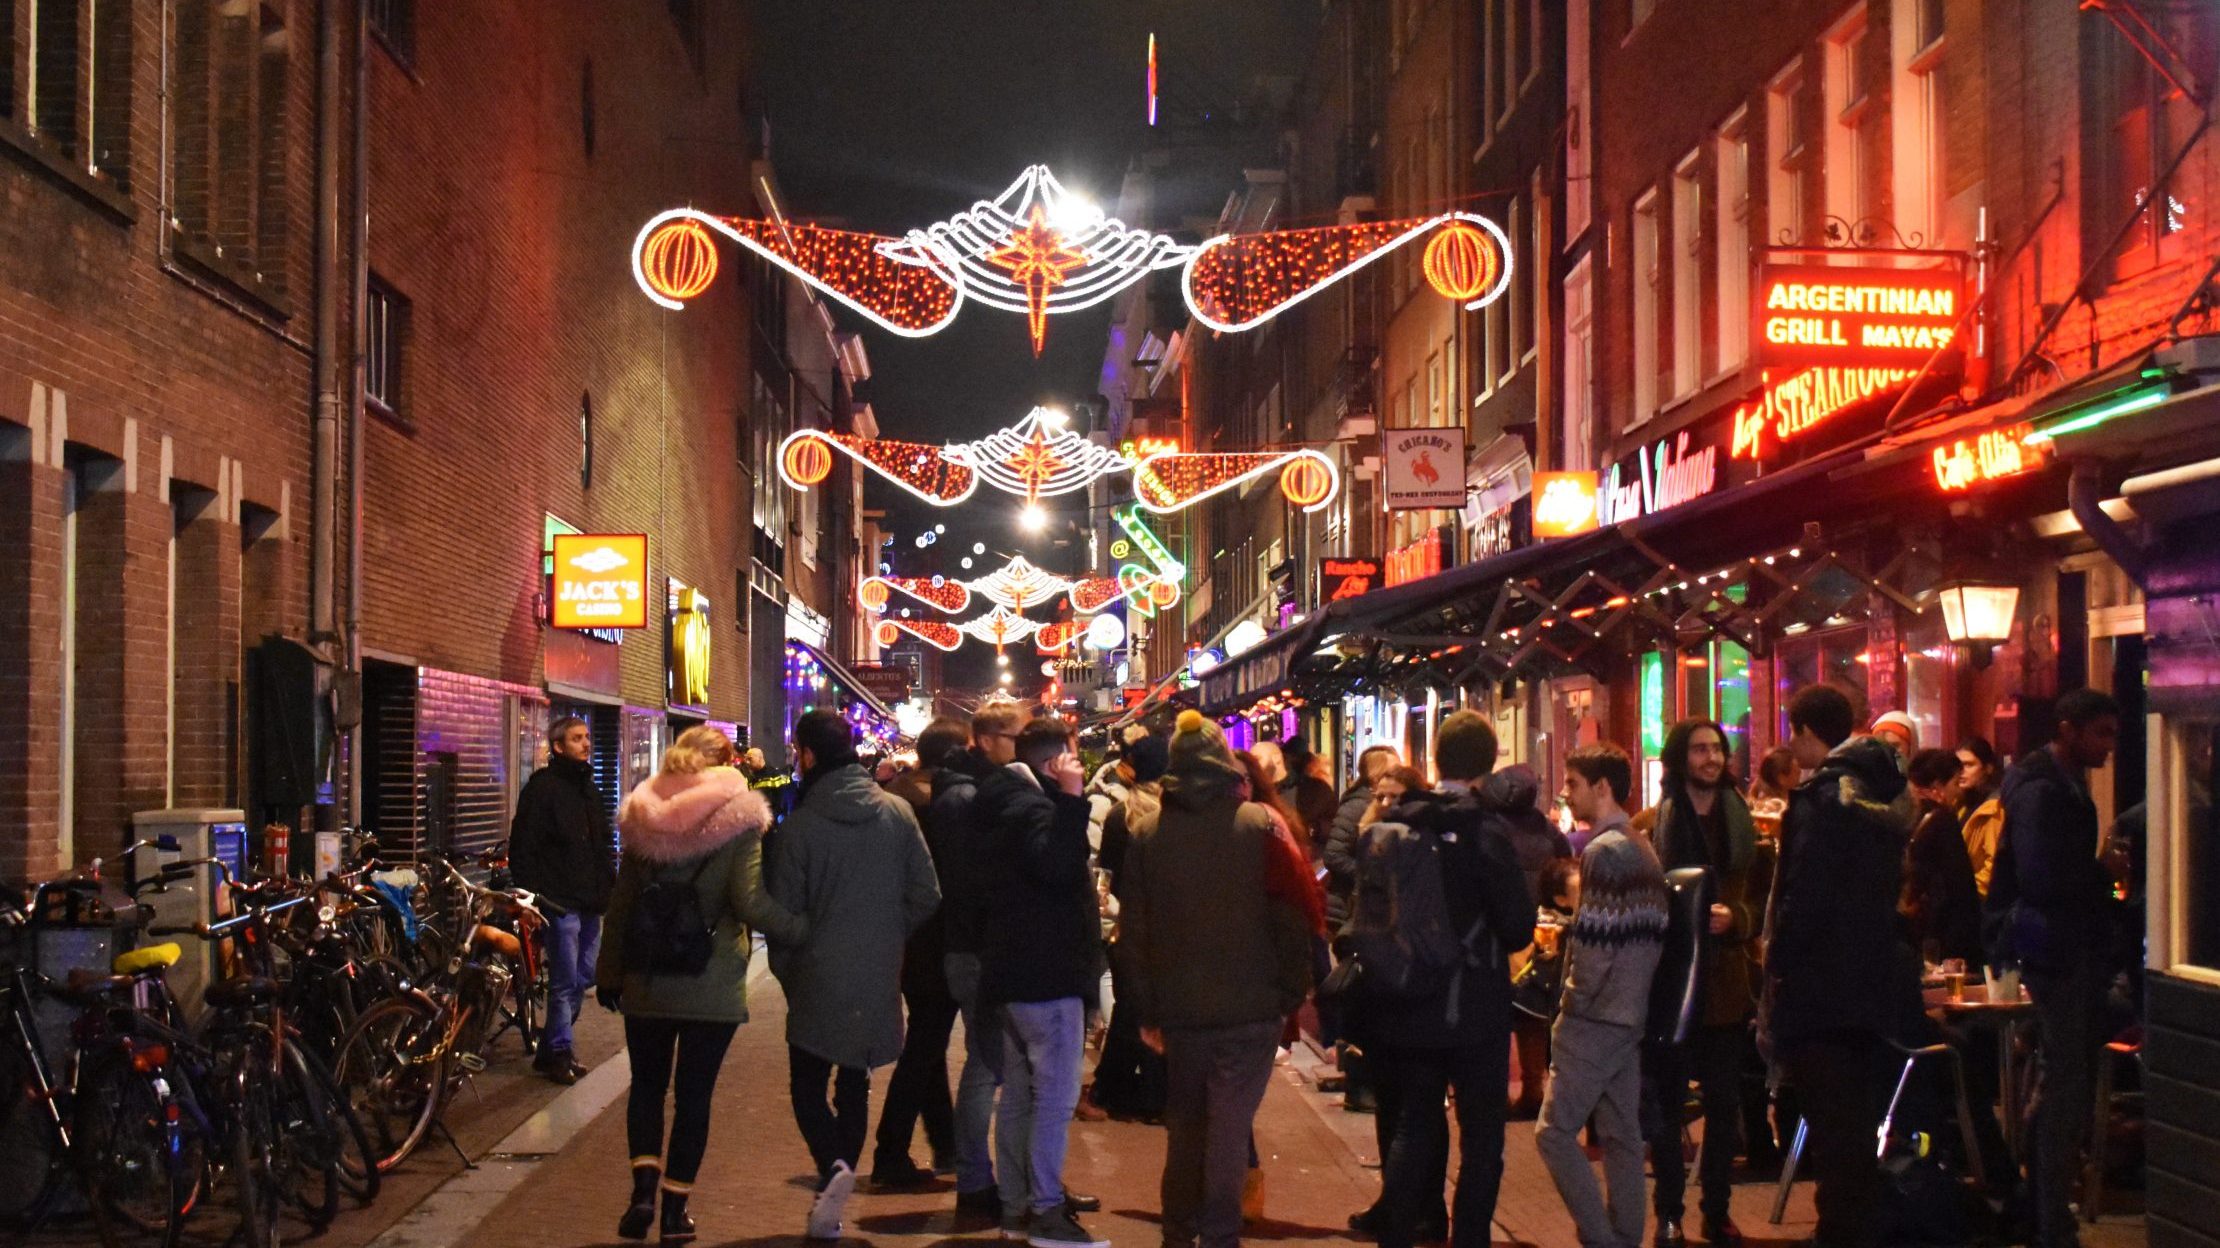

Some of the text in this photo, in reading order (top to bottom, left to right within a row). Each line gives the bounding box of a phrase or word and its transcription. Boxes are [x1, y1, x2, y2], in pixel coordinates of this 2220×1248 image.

[1767, 283, 1953, 316] ARGENTINIAN
[1766, 317, 1954, 349] GRILL MAYA'S
[1398, 435, 1453, 453] CHICANO'S
[559, 580, 640, 601] JACK'S
[576, 602, 623, 616] CASINO
